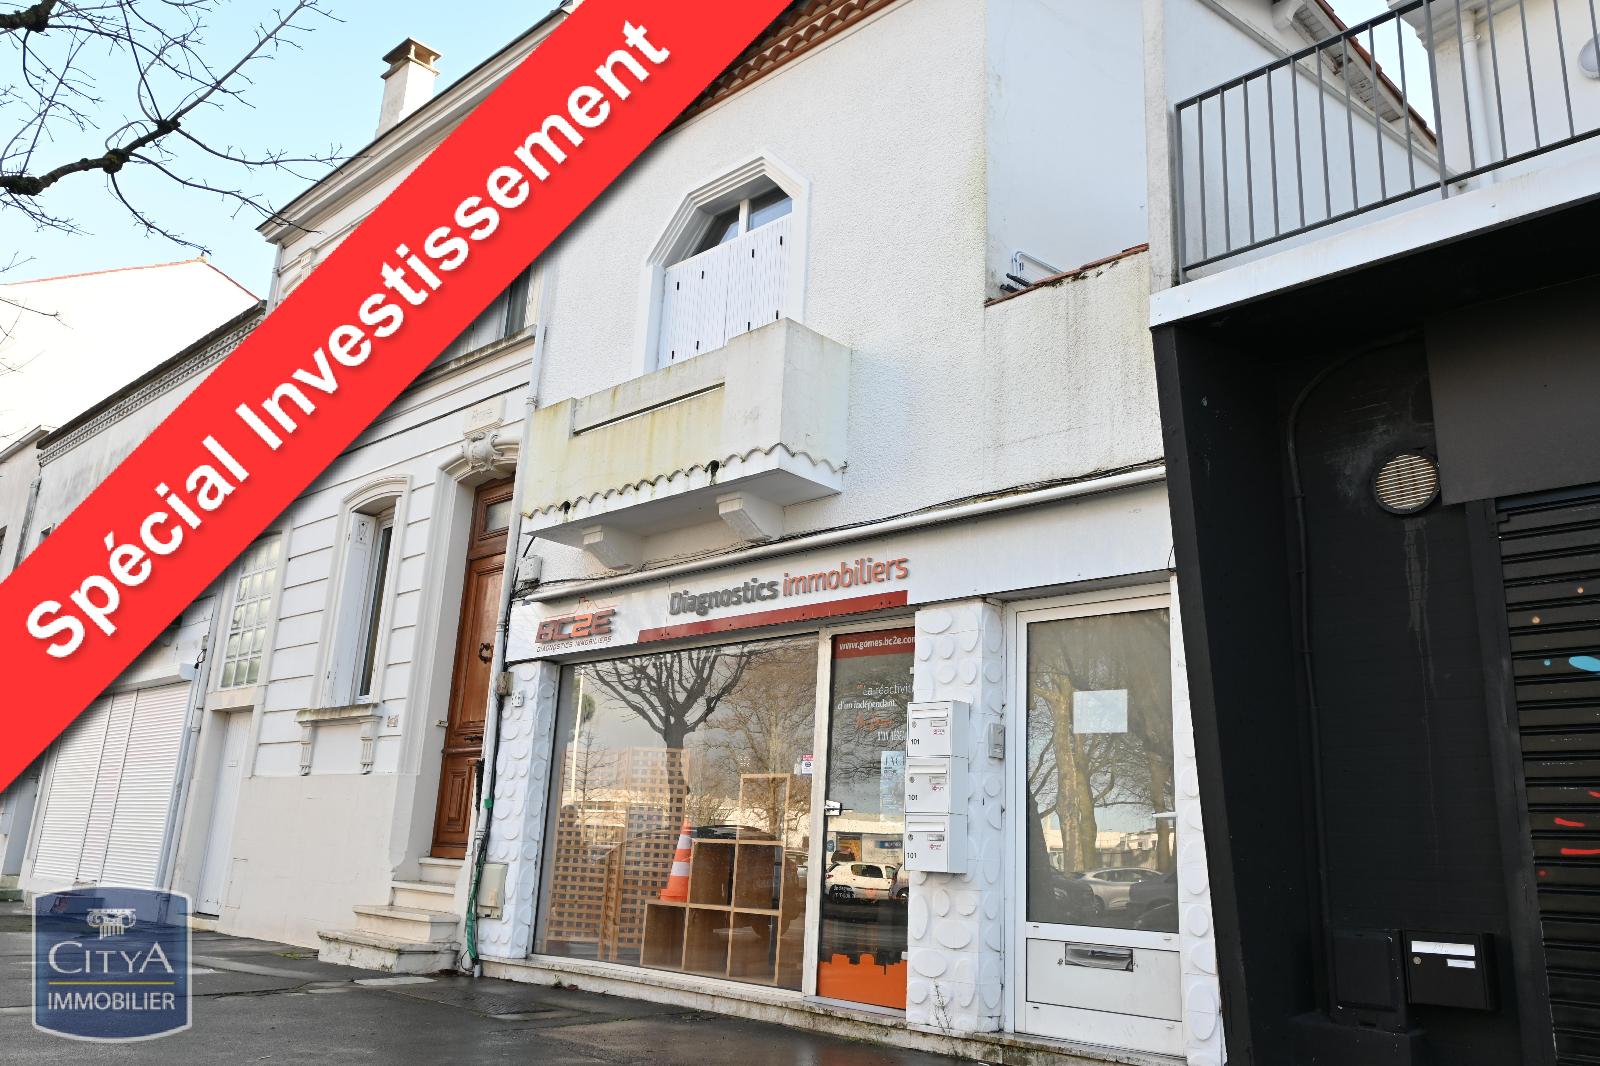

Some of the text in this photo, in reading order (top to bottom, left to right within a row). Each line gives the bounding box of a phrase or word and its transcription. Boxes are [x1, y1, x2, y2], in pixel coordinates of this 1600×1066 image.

[670, 558, 909, 616] Diagnostics immobiliers
[535, 609, 616, 643] BC2E
